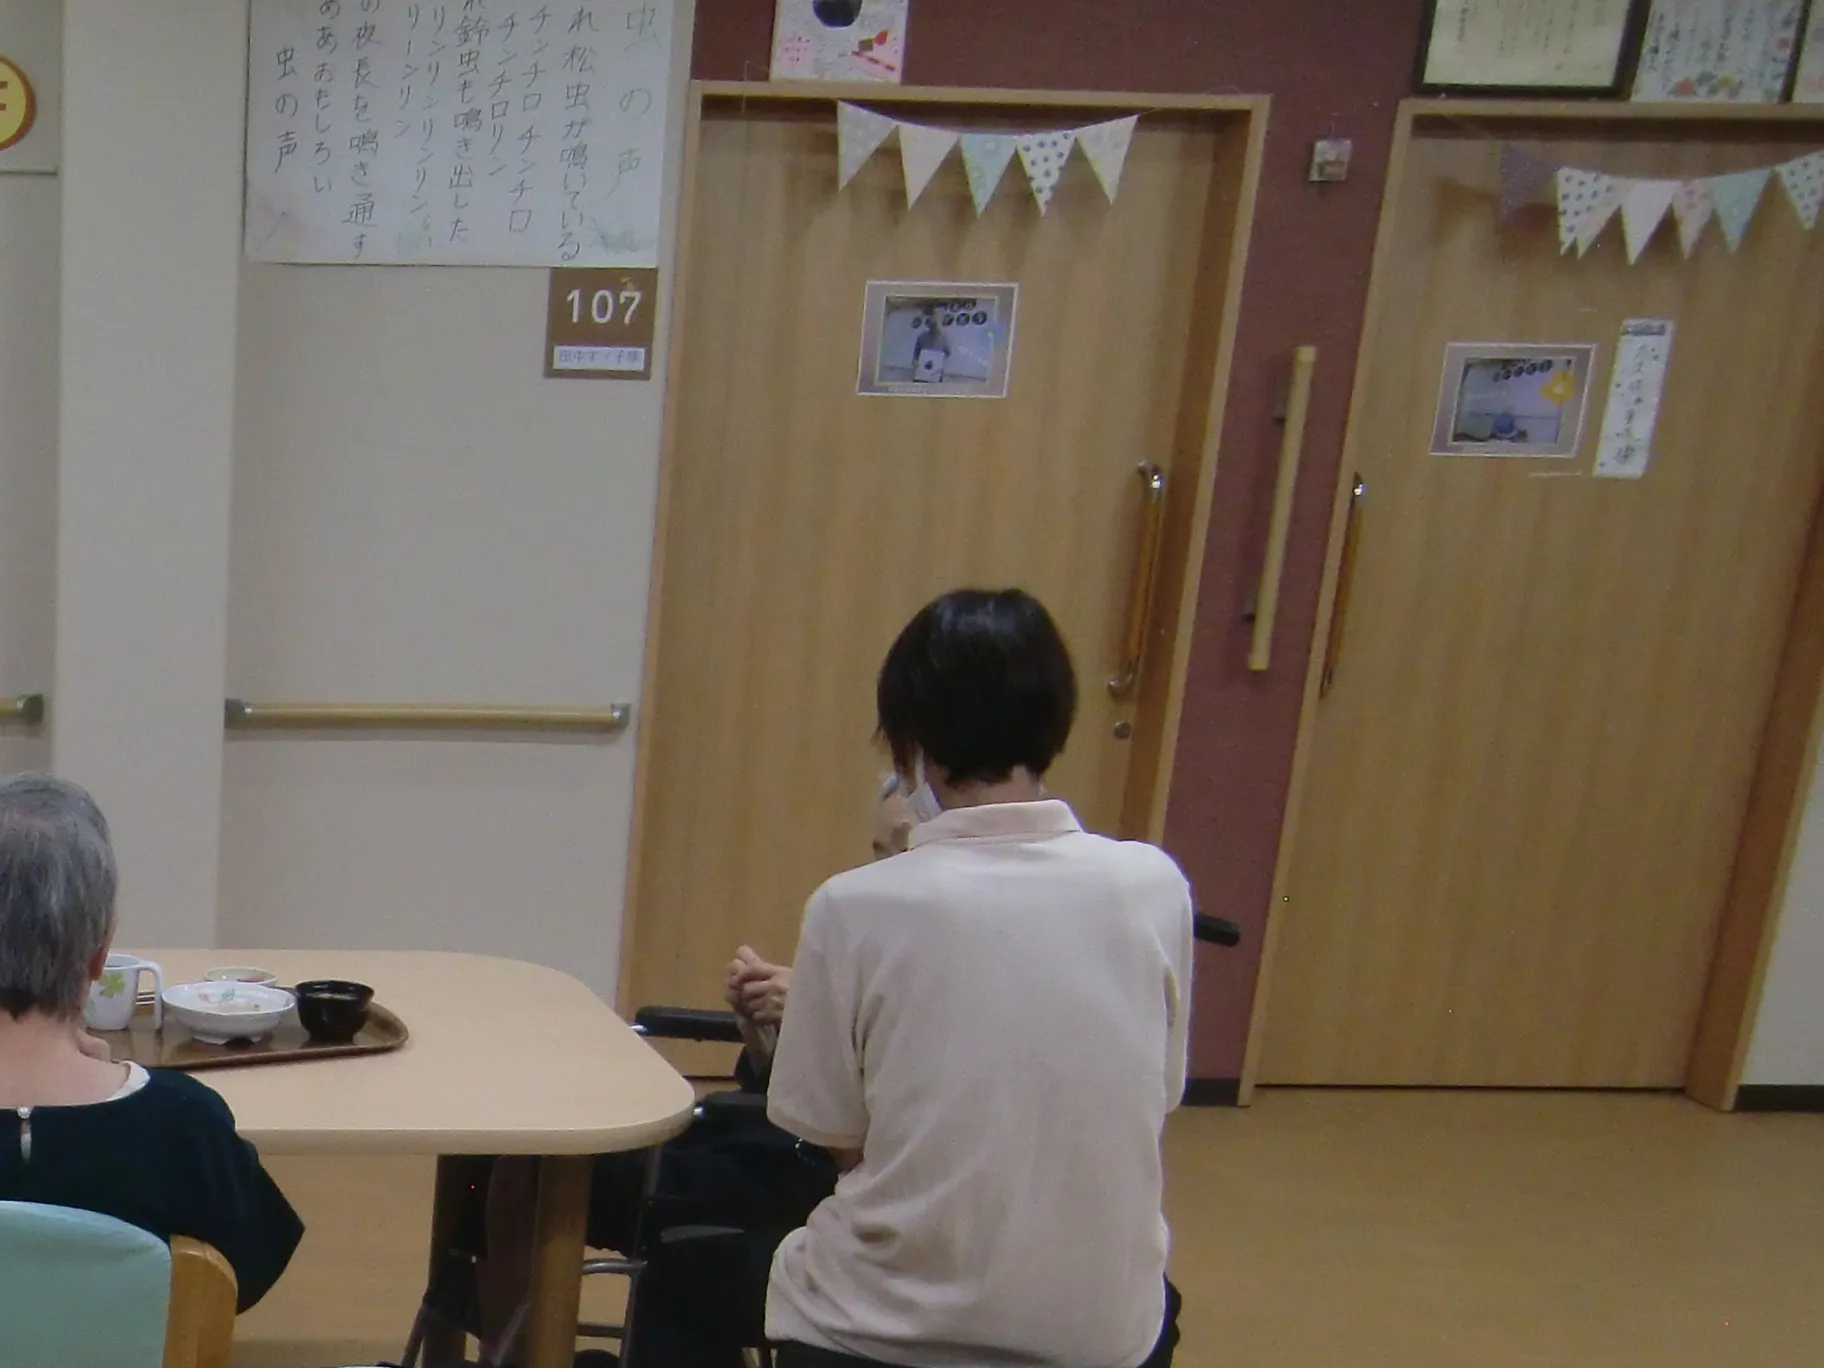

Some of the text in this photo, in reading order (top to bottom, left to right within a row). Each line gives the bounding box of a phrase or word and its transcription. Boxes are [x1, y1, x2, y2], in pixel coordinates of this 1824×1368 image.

[274, 45, 300, 175] 虫の声
[607, 1, 664, 198] 虫の声
[566, 288, 643, 325] 107
